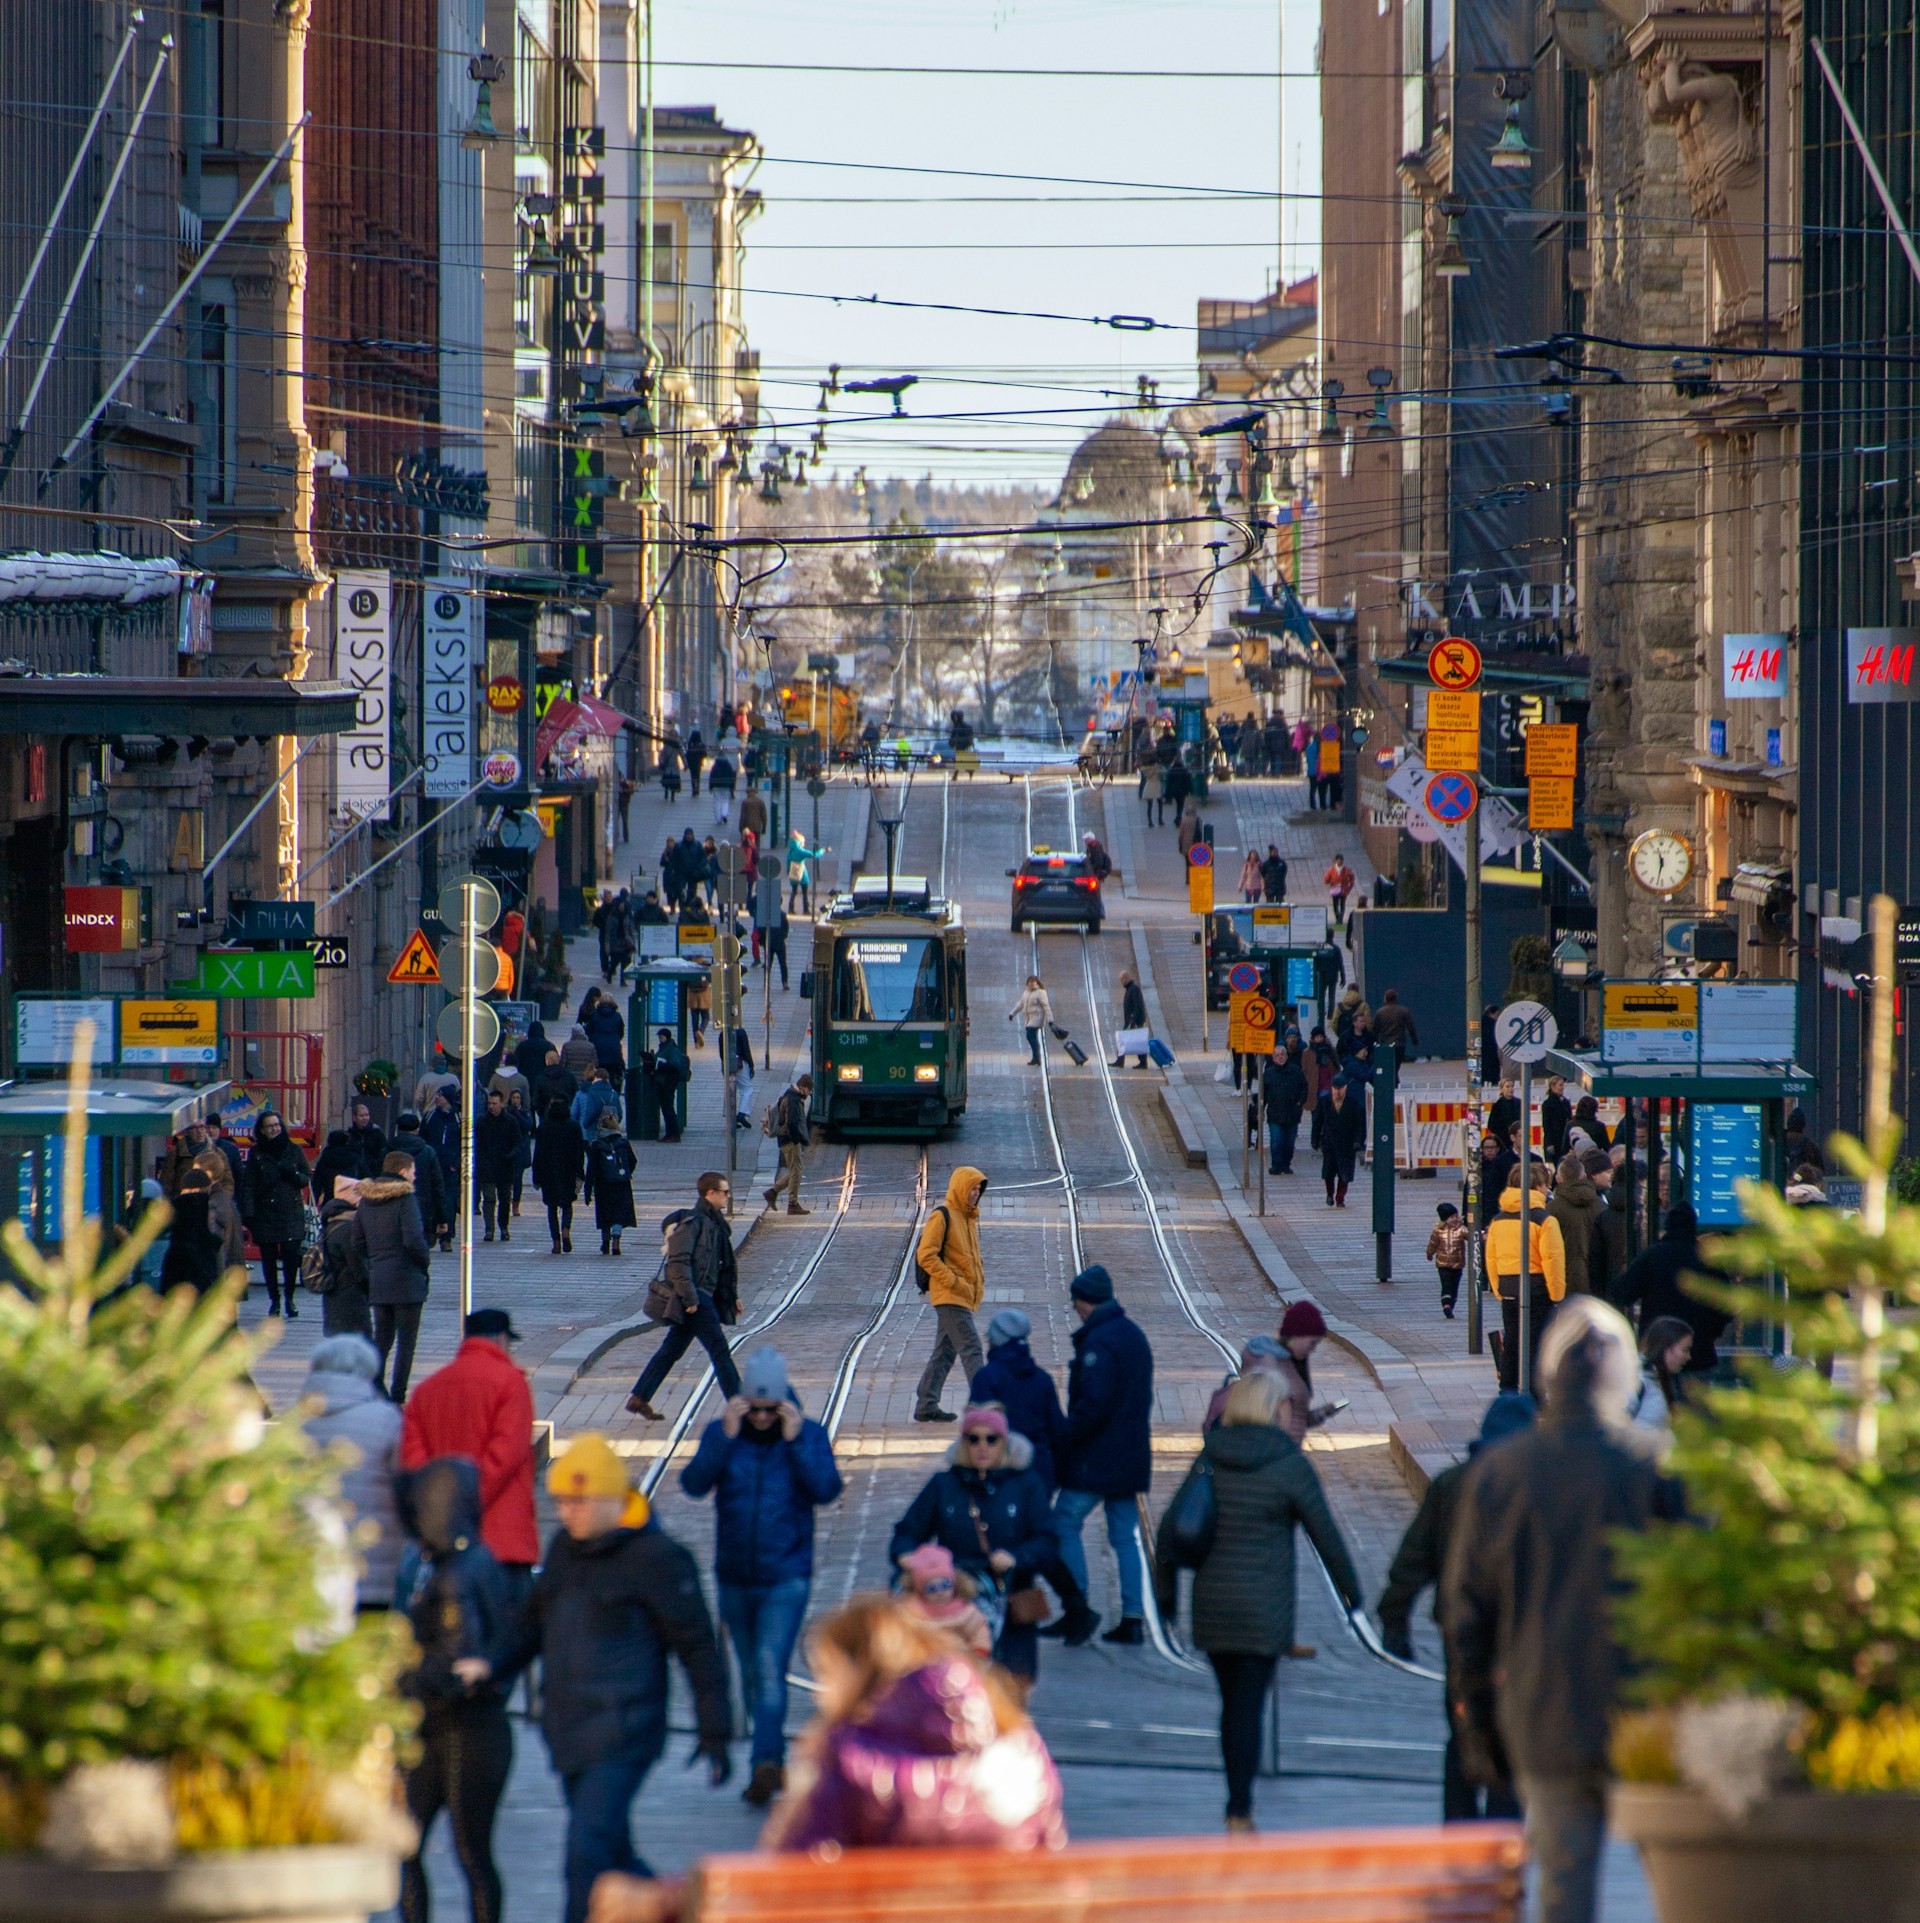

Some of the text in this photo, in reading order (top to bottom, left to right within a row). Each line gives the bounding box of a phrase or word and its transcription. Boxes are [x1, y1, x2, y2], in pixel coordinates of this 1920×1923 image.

[574, 448, 593, 573] XXL
[1730, 648, 1781, 683] H&M
[1856, 645, 1915, 686] H&M
[425, 627, 466, 755] aleksi
[488, 686, 520, 699] RAX
[338, 627, 384, 771] aleksi
[485, 767, 516, 777] KING
[65, 914, 114, 925] LINDEX
[305, 940, 347, 964] Zio
[847, 943, 908, 963] 4 MUNKKINIEMI
[1706, 987, 1713, 998] 4
[19, 1003, 27, 1015] 2
[19, 1018, 28, 1029] 4
[1667, 1019, 1694, 1027] H0401
[19, 1033, 27, 1045] 5
[1608, 1046, 1615, 1056] 2
[889, 1066, 906, 1078] 90
[1694, 1121, 1701, 1131] 2
[1751, 1138, 1760, 1148] 3
[44, 1148, 52, 1160] 2
[1694, 1156, 1700, 1166] 2
[44, 1167, 52, 1178] 4
[44, 1186, 52, 1197] 2
[1694, 1191, 1700, 1200] 2
[44, 1223, 52, 1234] 2
